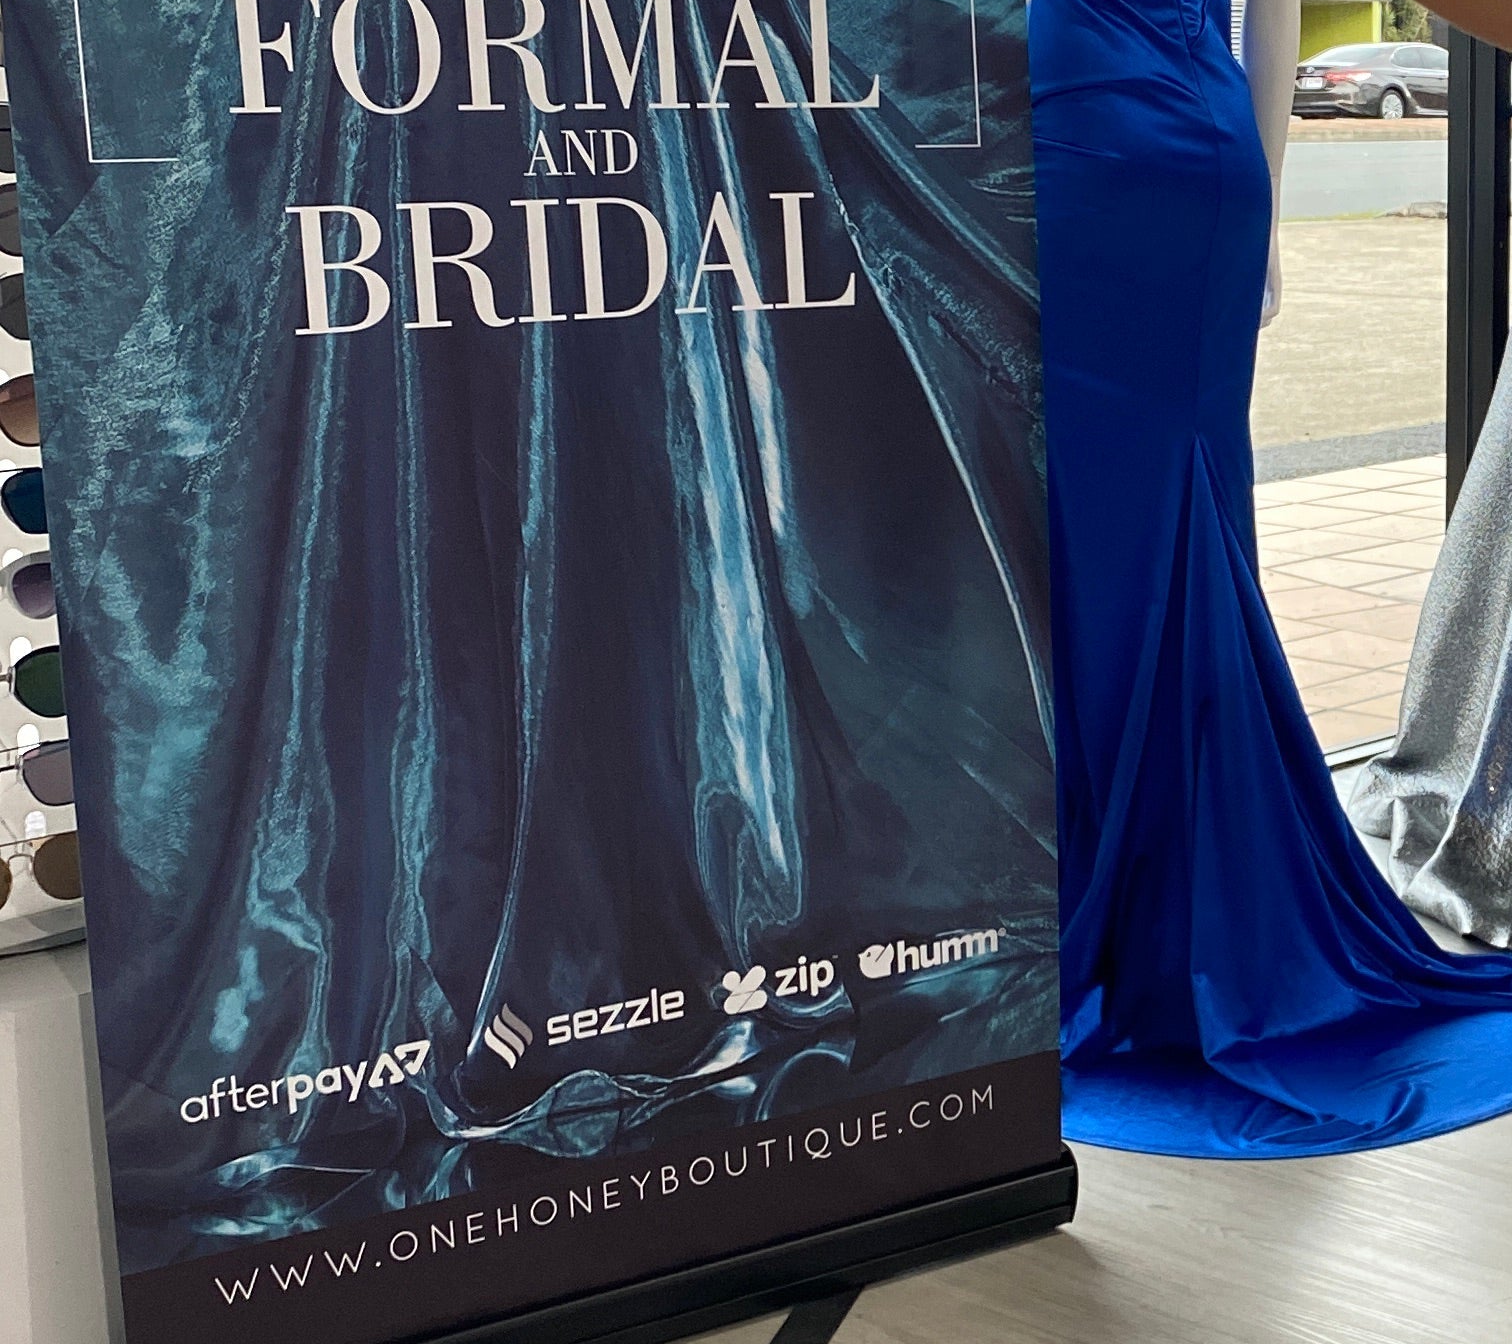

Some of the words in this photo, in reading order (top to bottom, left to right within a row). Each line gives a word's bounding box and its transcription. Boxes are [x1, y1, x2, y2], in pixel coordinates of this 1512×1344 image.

[523, 129, 639, 177] AND
[285, 191, 856, 336] BRIDAL
[774, 956, 835, 997] zip
[896, 928, 999, 974] humm
[546, 988, 685, 1046] sezzle
[179, 1059, 370, 1124] afterpay
[213, 1083, 994, 1305] WWW.ONEHONEYBOUTIQUE.COM
